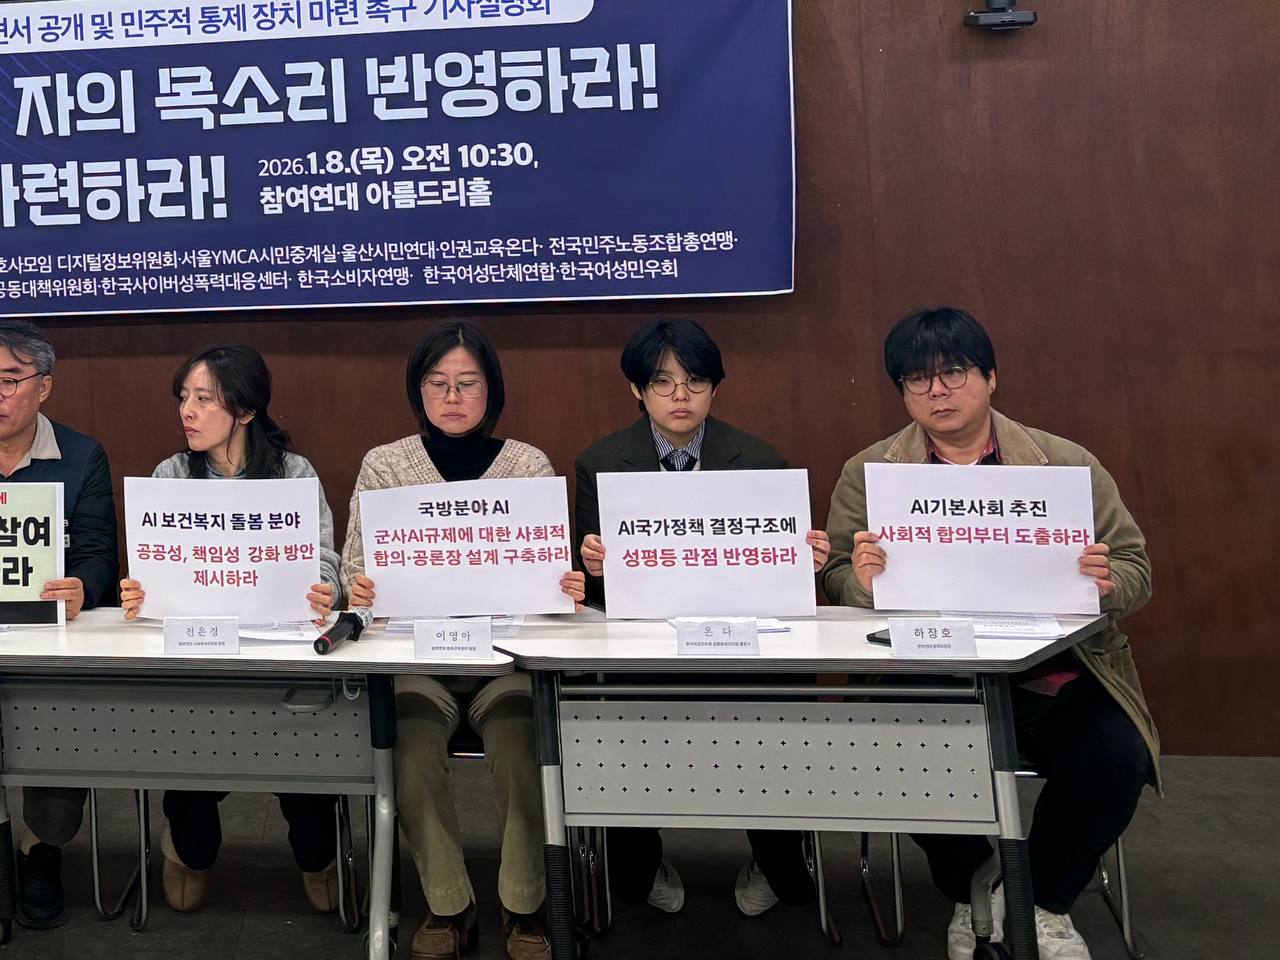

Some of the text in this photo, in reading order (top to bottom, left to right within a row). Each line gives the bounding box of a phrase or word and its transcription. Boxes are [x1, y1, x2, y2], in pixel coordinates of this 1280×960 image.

[38, 13, 84, 43] 공개
[92, 13, 114, 41] 및
[121, 6, 192, 38] 민주적
[198, 3, 248, 34] 통제
[253, 0, 303, 30] 장치
[15, 66, 136, 137] 자의
[154, 57, 348, 131] 목소리
[365, 43, 659, 122] 반영하라!
[257, 142, 539, 178] 2026.1.8.(목) 오전 10:30,
[259, 176, 492, 215] 참여연대 아름드리홀
[418, 499, 510, 517] 국방분야 AI
[910, 498, 1048, 518] AI기본사회 추진
[141, 512, 301, 531] AI 보건복지 돌봄 분야
[618, 516, 797, 537] AI국가정책 결정구조에
[374, 524, 566, 545] 군사AI규제에 대한 사회적
[878, 525, 1090, 546] 사회적 합의부터 도출하라
[136, 543, 315, 564] 공공성, 책임성 강화 방안
[373, 546, 570, 567] 합의·공론장 설계 구축하라
[622, 546, 798, 568] 성평등 관점 반영하라
[193, 569, 258, 588] 제시하라
